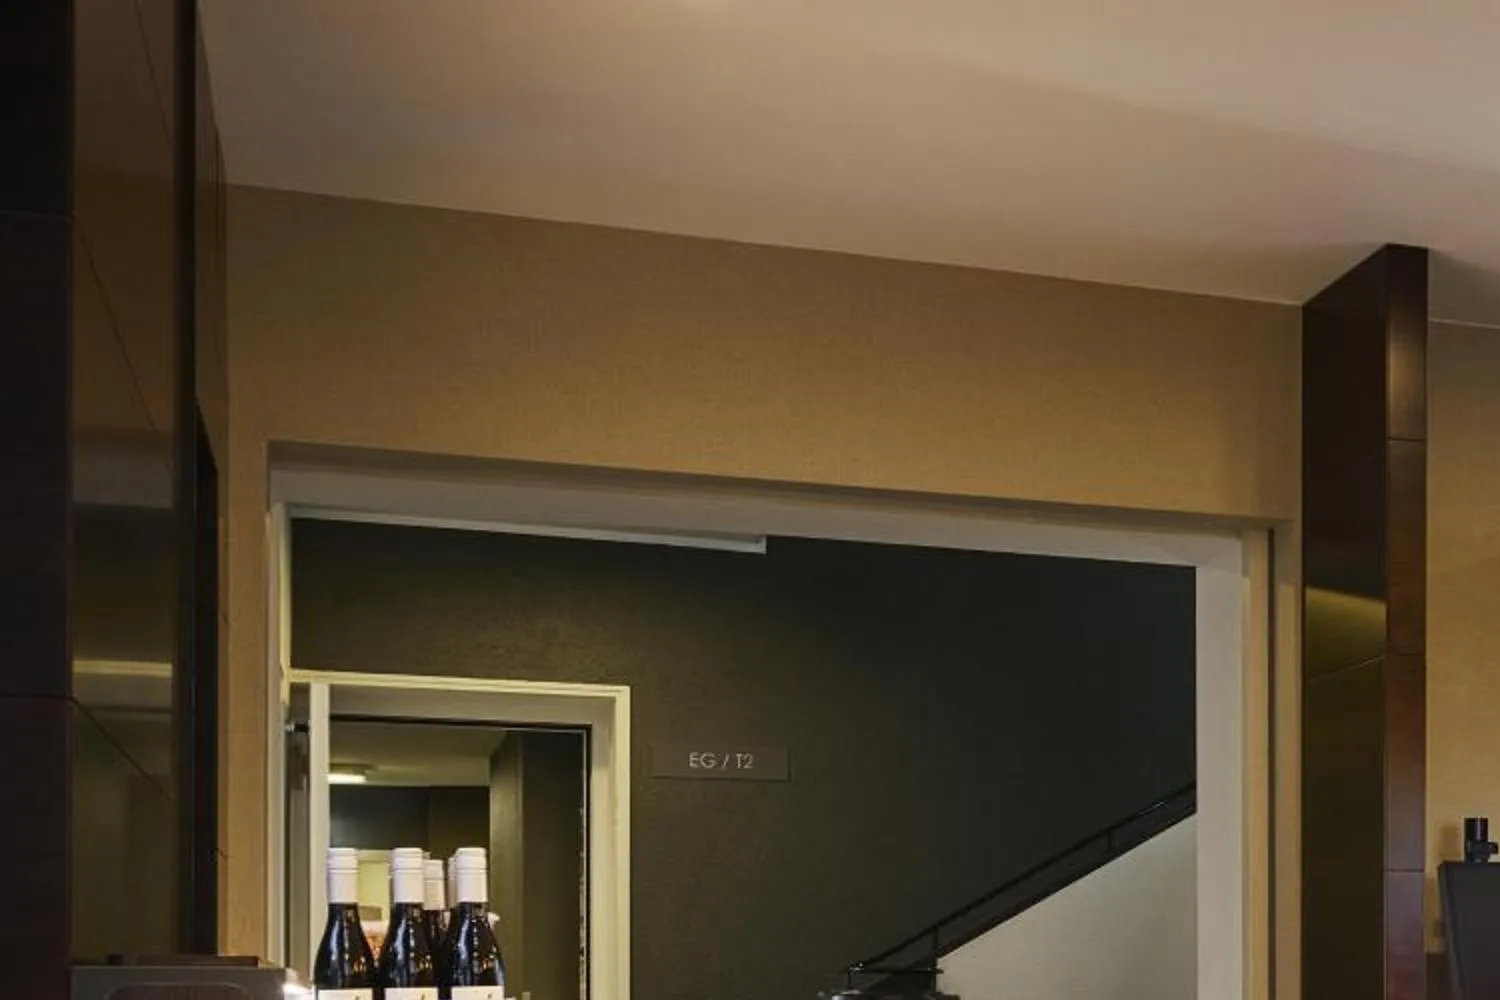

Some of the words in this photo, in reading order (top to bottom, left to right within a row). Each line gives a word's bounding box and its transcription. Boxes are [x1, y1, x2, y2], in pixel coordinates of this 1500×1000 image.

[689, 752, 717, 769] EG
[721, 753, 730, 771] /
[735, 752, 754, 769] T2
